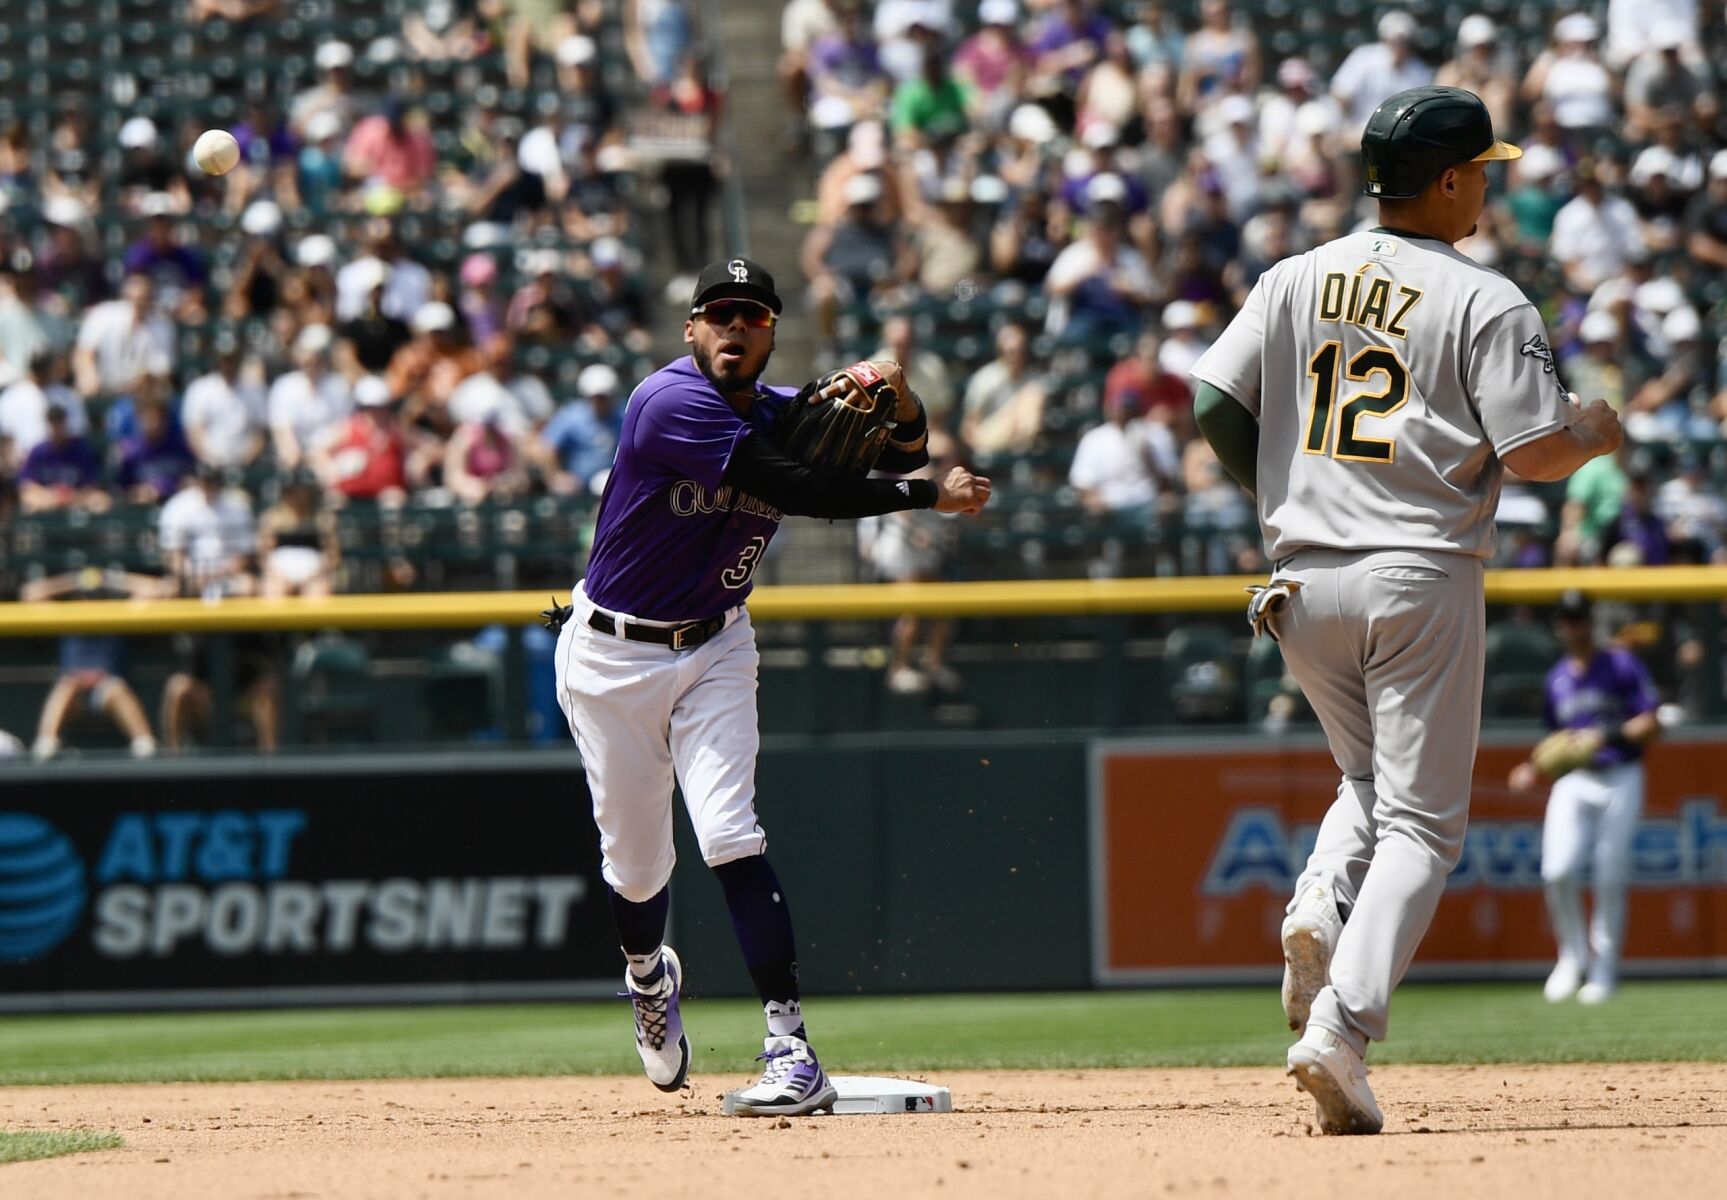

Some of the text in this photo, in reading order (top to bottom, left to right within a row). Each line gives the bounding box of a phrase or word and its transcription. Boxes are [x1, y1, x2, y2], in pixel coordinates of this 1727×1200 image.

[1318, 262, 1424, 339] DÍAZ
[1303, 340, 1411, 463] 12
[721, 536, 765, 589] 3
[98, 809, 306, 880] AT&T
[95, 876, 583, 955] SPORTSNET
